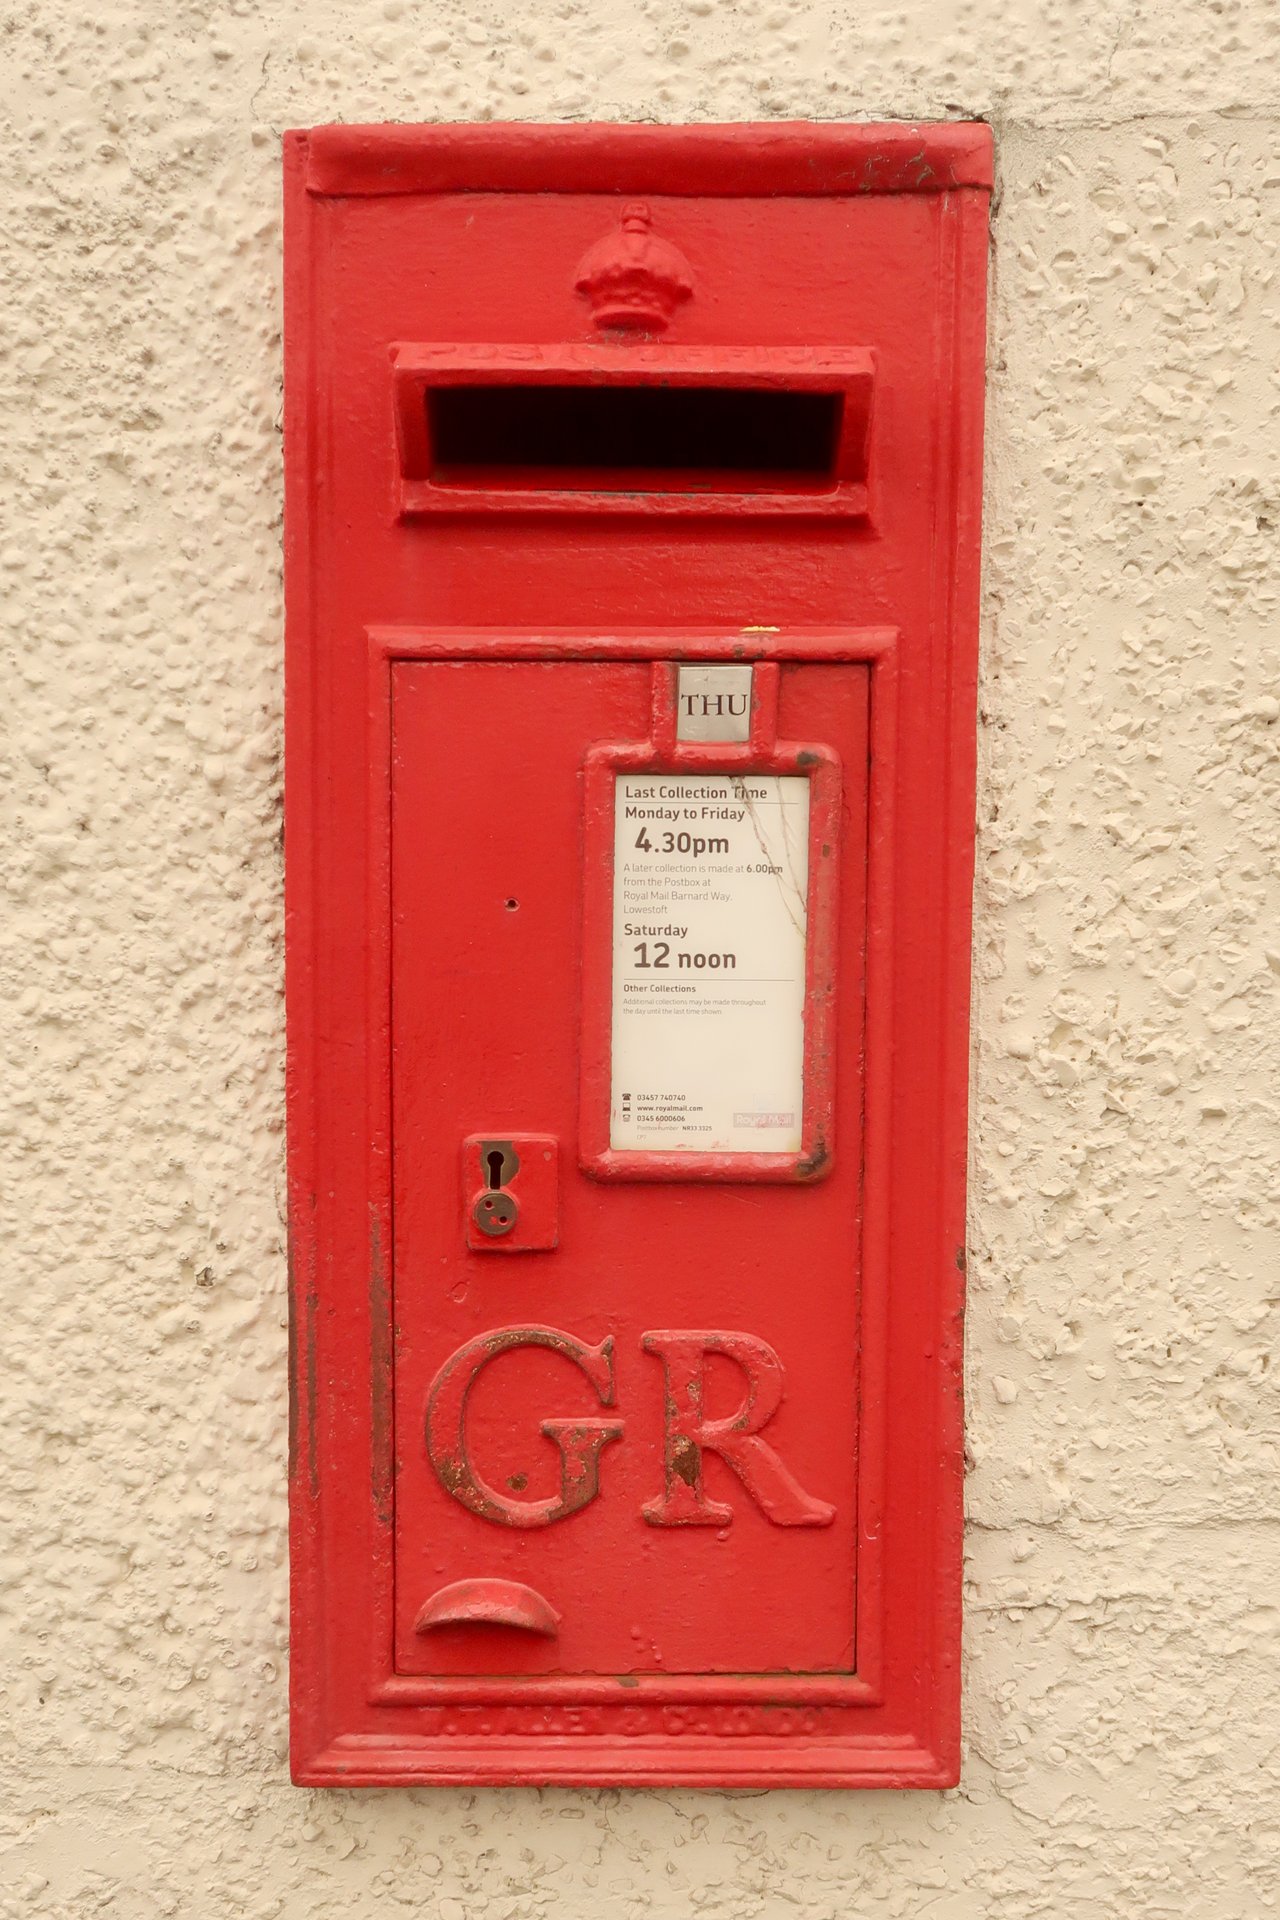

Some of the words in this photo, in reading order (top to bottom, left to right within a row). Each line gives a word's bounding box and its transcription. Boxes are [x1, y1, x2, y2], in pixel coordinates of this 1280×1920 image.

[681, 694, 748, 716] THU
[625, 785, 656, 799] Last
[659, 785, 727, 799] Collection
[731, 785, 767, 799] Time
[625, 806, 680, 822] Monday
[684, 808, 697, 819] to
[701, 806, 745, 822] Friday
[634, 827, 729, 858] 4.30pm
[623, 864, 631, 873] A
[632, 864, 652, 873] later
[654, 864, 697, 873] collection
[699, 864, 706, 873] is
[708, 864, 733, 873] made
[735, 864, 744, 873] at
[746, 864, 783, 874] 6.00pm
[623, 878, 645, 887] from
[647, 878, 662, 887] the
[664, 878, 698, 887] Postbox
[700, 878, 711, 887] at
[623, 891, 648, 902] Royal
[651, 891, 669, 901] Mail
[671, 892, 708, 901] Barnard
[623, 905, 668, 914] Lowestoft
[624, 924, 688, 938] Saturday
[634, 942, 670, 969] 12
[678, 953, 736, 969] noon
[623, 985, 647, 993] Other
[650, 985, 696, 993] Collections
[623, 1008, 633, 1016] the
[634, 1008, 646, 1016] day
[647, 1008, 661, 1016] until
[662, 1008, 672, 1016] the
[674, 1008, 685, 1016] last
[686, 1008, 700, 1016] time
[426, 1323, 837, 1528] GR
